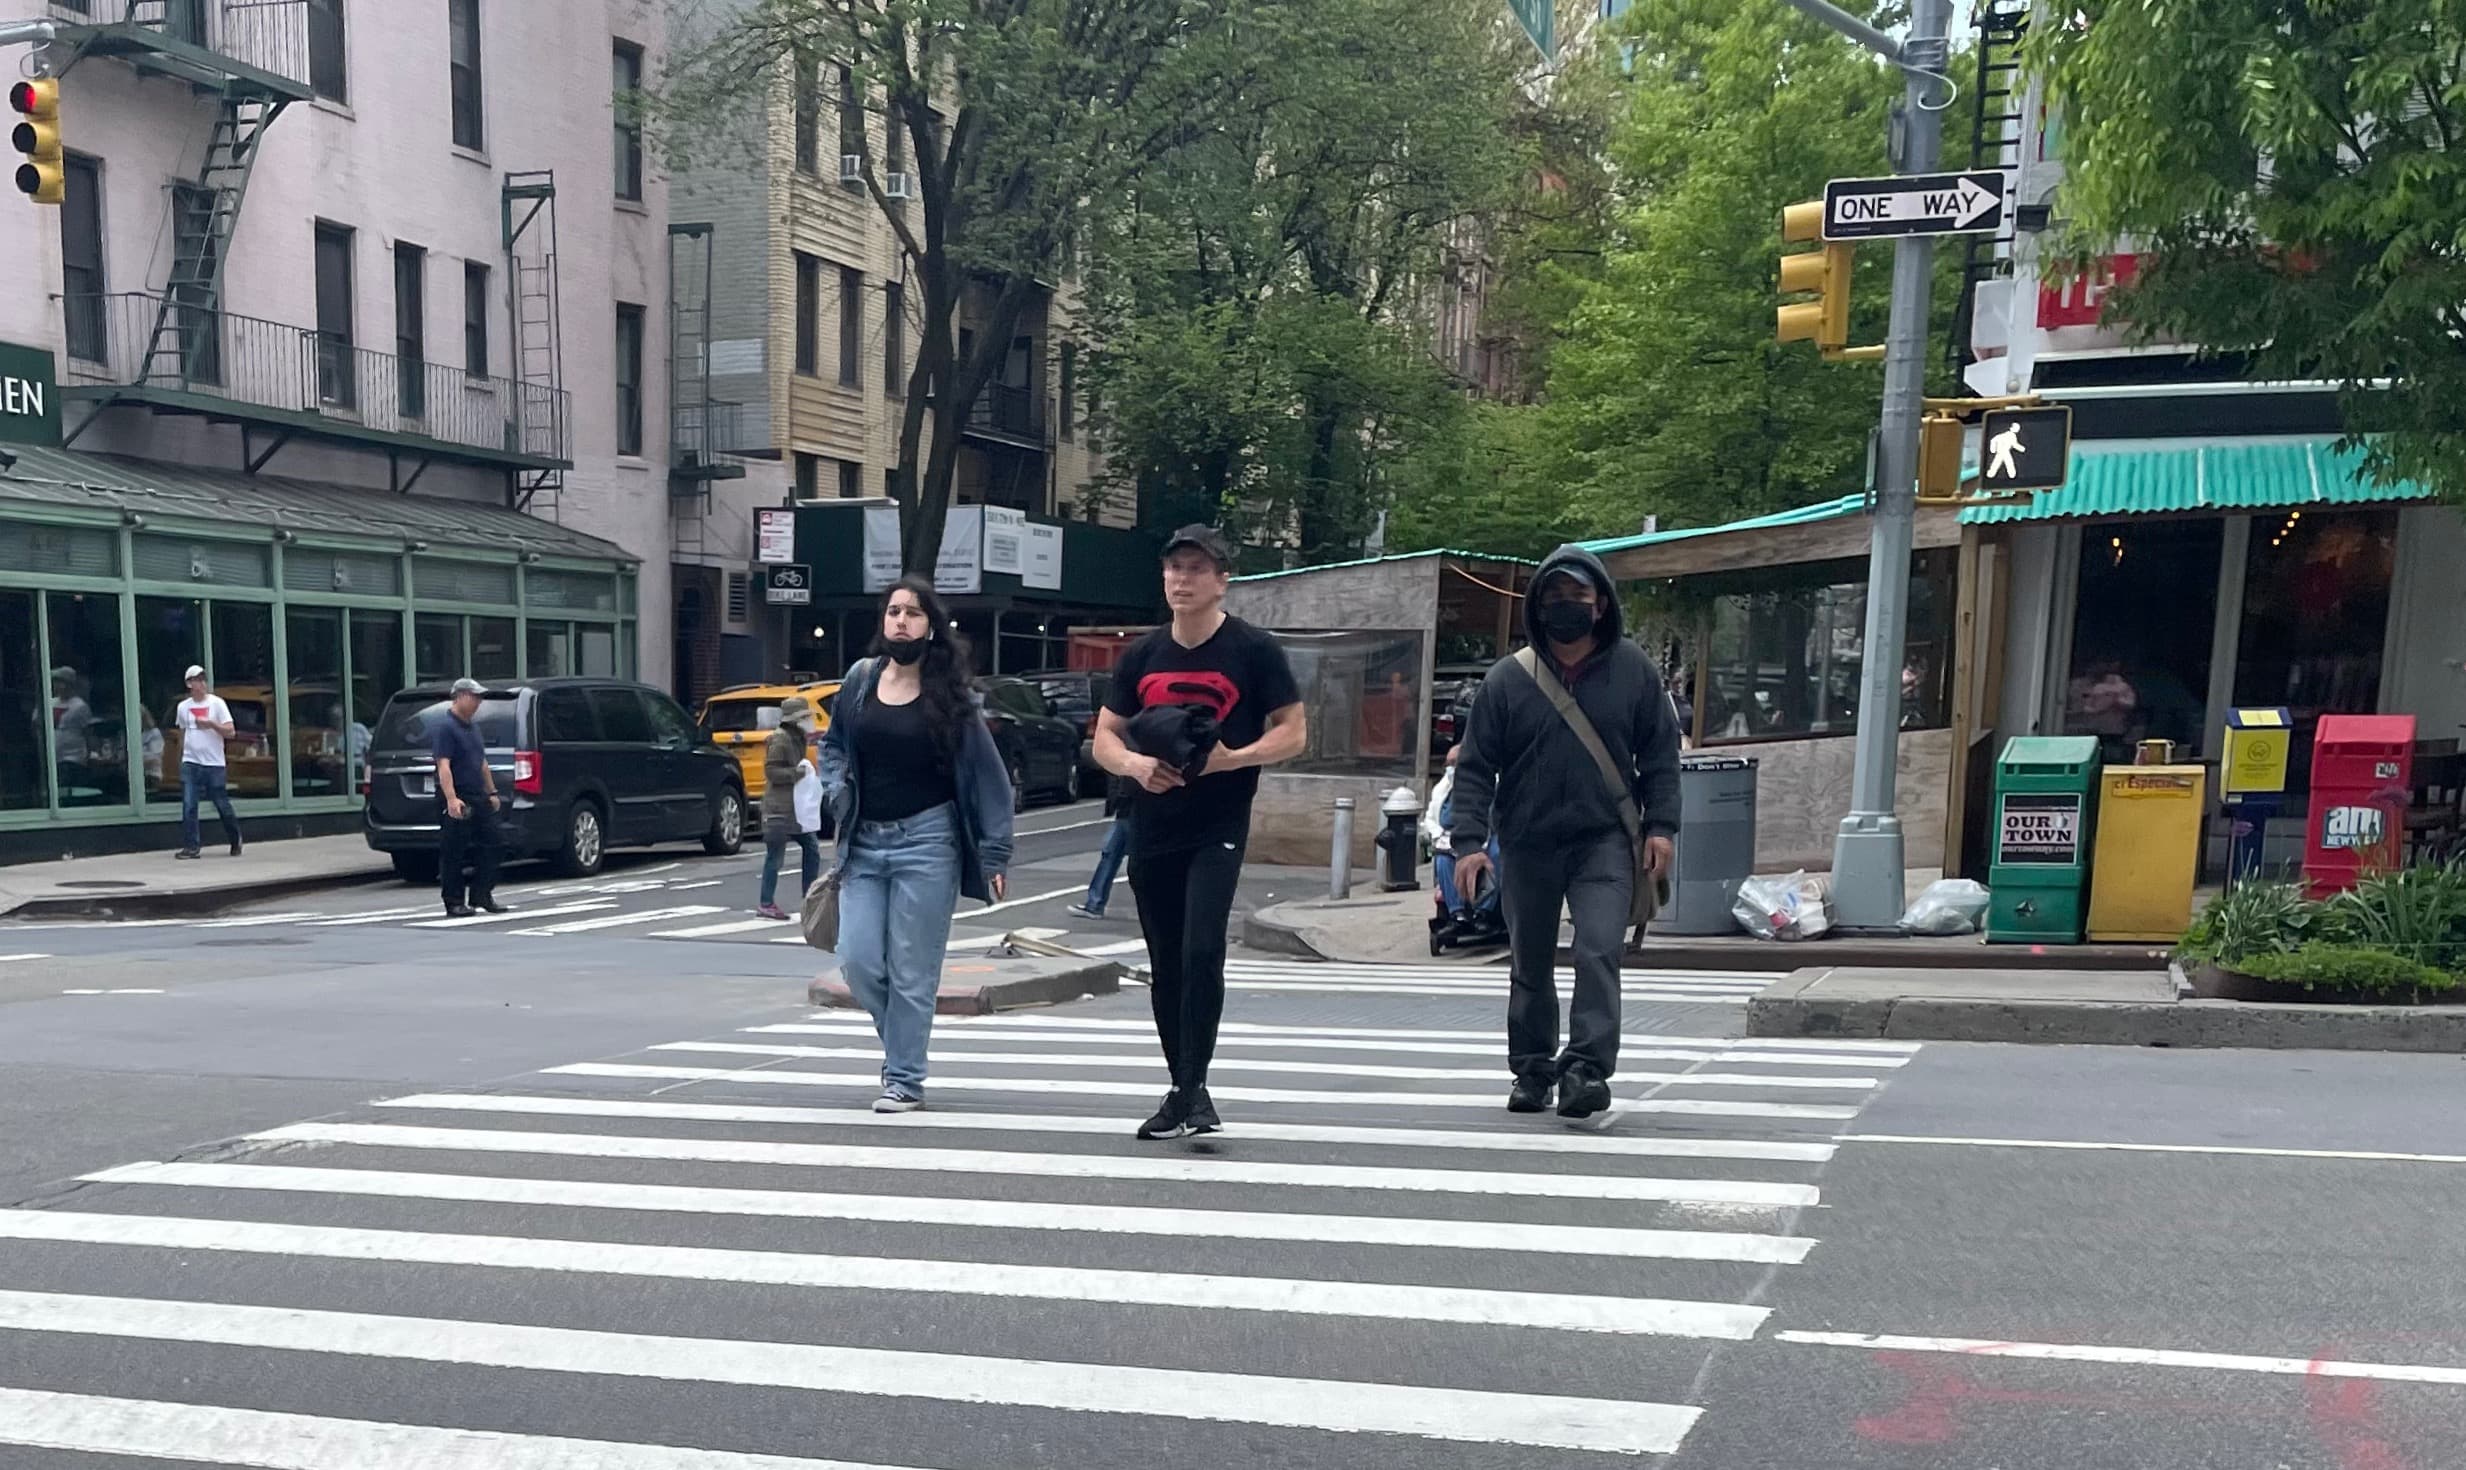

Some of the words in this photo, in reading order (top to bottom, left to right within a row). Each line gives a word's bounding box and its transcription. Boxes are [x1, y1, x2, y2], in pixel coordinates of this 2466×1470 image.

[1840, 197, 1893, 220] ONE
[1923, 192, 1980, 215] WAY
[0, 376, 44, 416] EN
[2006, 815, 2052, 828] OUR
[2005, 829, 2073, 842] TOWN
